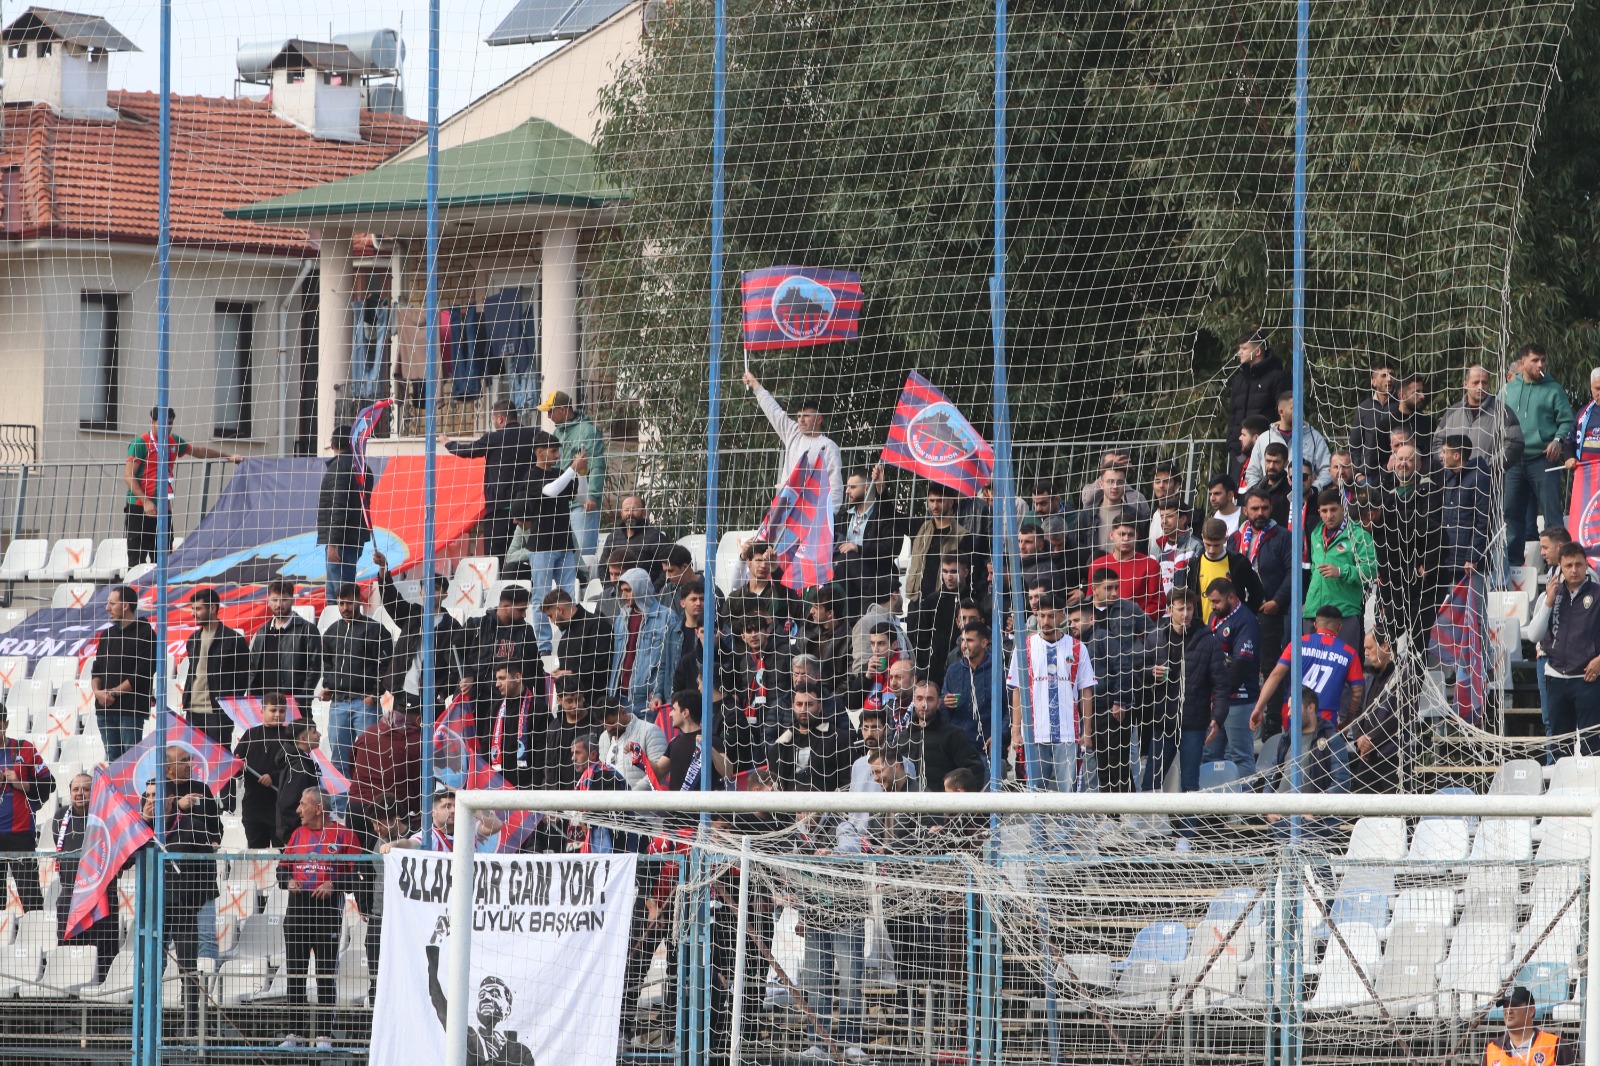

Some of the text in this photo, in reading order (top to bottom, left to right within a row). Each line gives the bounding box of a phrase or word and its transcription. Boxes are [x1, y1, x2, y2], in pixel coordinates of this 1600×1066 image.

[1328, 651, 1349, 667] SPOR
[1301, 663, 1334, 694] 47
[509, 860, 552, 906] GAM
[558, 860, 599, 906] YOK
[473, 904, 605, 938] ÜYÜK BAŞKAN
